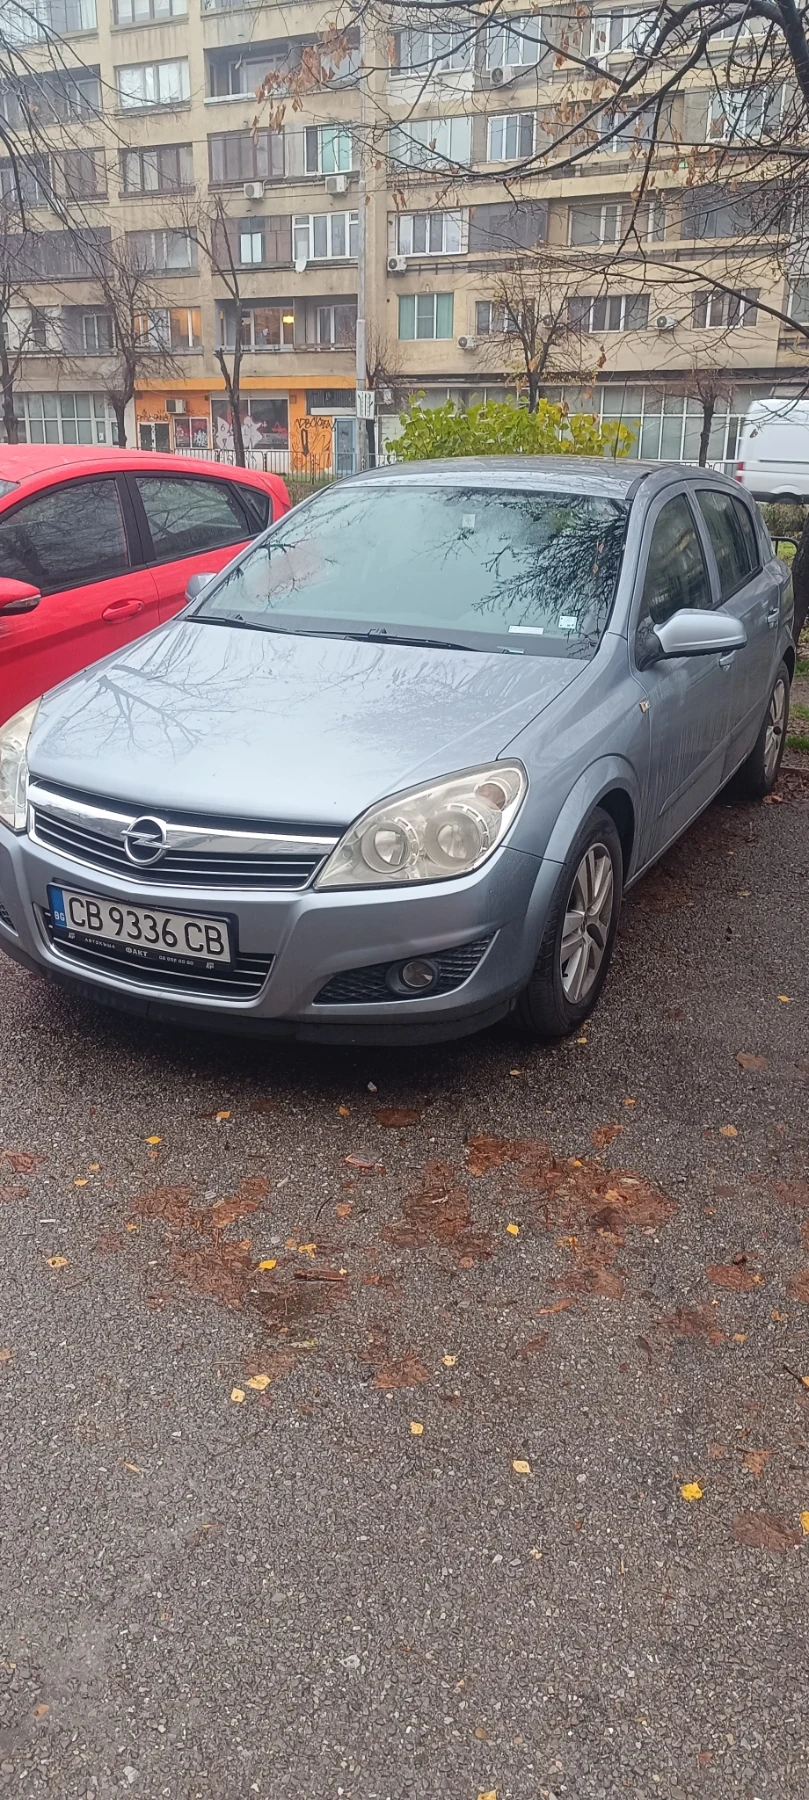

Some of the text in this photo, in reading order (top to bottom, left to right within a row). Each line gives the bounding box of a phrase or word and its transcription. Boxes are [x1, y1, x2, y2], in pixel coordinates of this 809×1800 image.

[54, 910, 65, 922] BG
[68, 896, 225, 955] CB 9336 CB
[125, 946, 148, 957] ФАКТ
